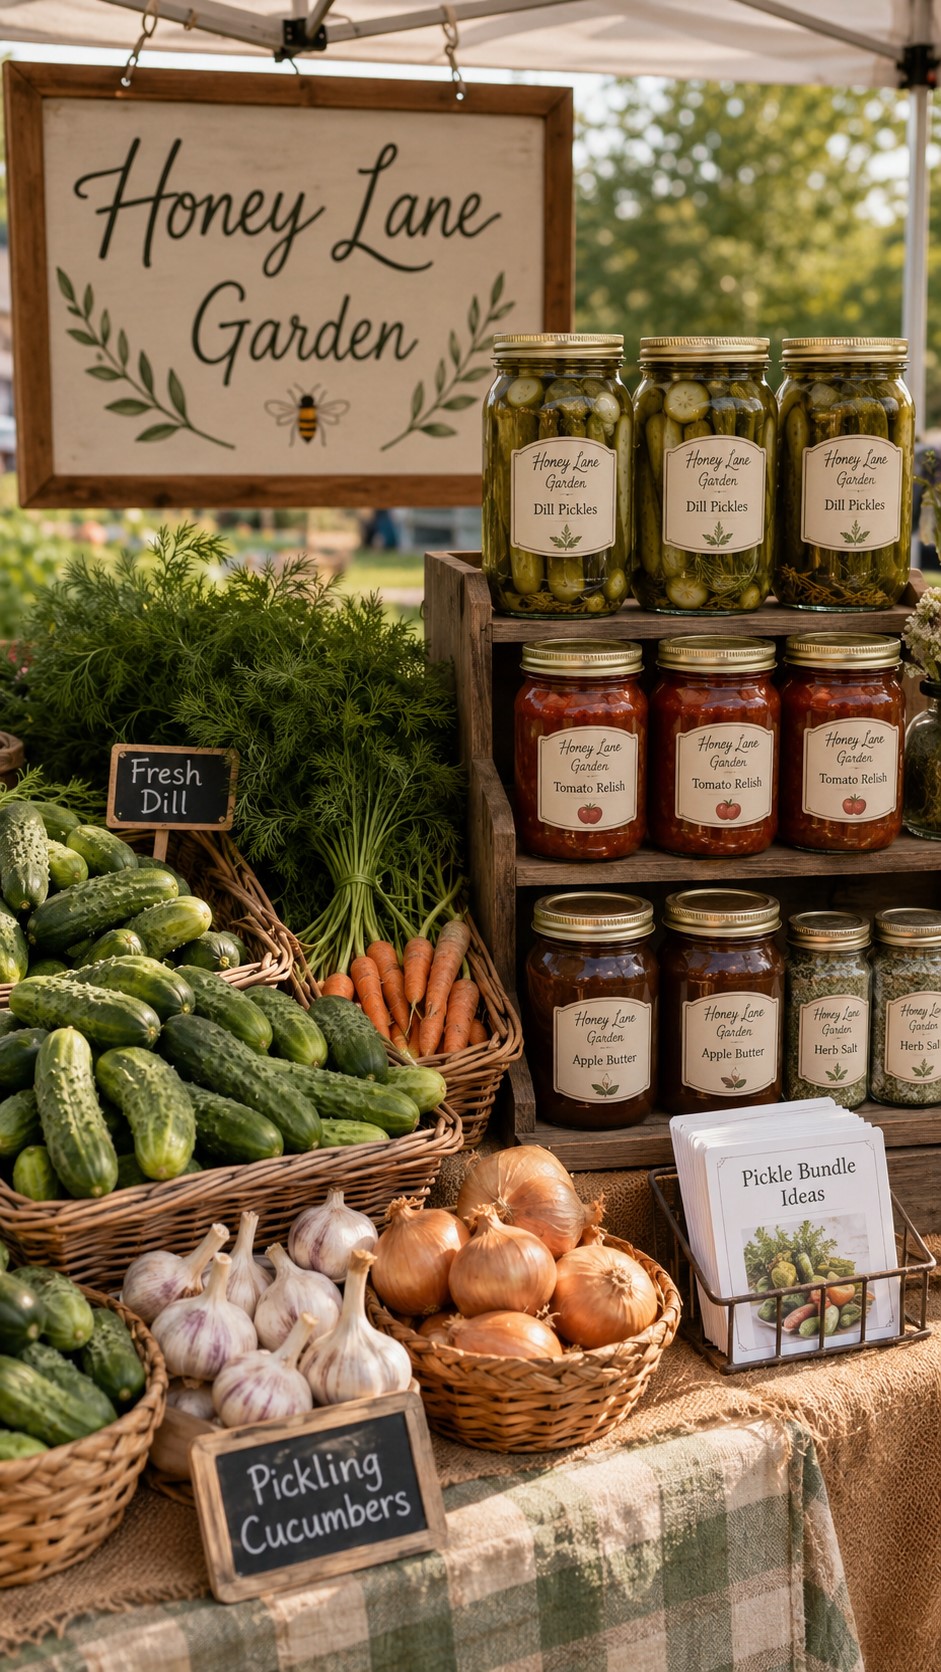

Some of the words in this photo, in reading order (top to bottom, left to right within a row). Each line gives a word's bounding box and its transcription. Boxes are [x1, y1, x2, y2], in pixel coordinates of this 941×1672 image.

[74, 137, 326, 277] Honey
[331, 143, 502, 273] Lane
[191, 280, 419, 386] Garden
[532, 451, 571, 474] Honey
[573, 450, 600, 473] Lane
[686, 450, 723, 472] Honey
[725, 449, 751, 471] Lane
[824, 449, 861, 471] Honey
[863, 448, 888, 469] Lane
[545, 473, 587, 491] Garden
[698, 471, 738, 489] Garden
[836, 470, 876, 488] Garden
[533, 502, 554, 516] Dill
[558, 502, 598, 516] Pickles
[686, 500, 707, 513] Dill
[710, 500, 748, 513] Pickles
[824, 499, 845, 511] Dill
[848, 499, 886, 511] Pickles
[559, 738, 595, 759] Honey
[596, 737, 622, 757] Lane
[698, 735, 733, 757] Honey
[735, 733, 760, 753] Lane
[825, 731, 860, 750] Honey
[861, 730, 885, 749] Lane
[570, 758, 610, 773] Garden
[709, 754, 748, 771] Garden
[836, 750, 873, 766] Garden
[131, 757, 202, 786] Fresh
[819, 772, 858, 785] Tomato
[861, 772, 888, 785] Relish
[553, 781, 593, 794] Tomato
[596, 780, 626, 793] Relish
[692, 777, 732, 791] Tomato
[734, 777, 762, 790] Relish
[140, 788, 187, 815] Dill
[574, 1010, 610, 1031] Honey
[611, 1009, 637, 1029] Lane
[704, 1005, 739, 1025] Honey
[740, 1003, 766, 1023] Lane
[813, 1006, 841, 1023] Honey
[586, 1029, 625, 1046] Garden
[716, 1024, 753, 1040] Garden
[821, 1023, 852, 1037] Garden
[701, 1047, 732, 1062] Apple
[735, 1047, 765, 1059] Butter
[814, 1044, 839, 1055] Herb
[841, 1043, 858, 1055] Salt
[900, 1040, 924, 1051] Herb
[572, 1054, 604, 1069] Apple
[606, 1053, 637, 1066] Butter
[741, 1164, 793, 1188] Pickle
[797, 1157, 857, 1181] Bundle
[781, 1187, 825, 1208] Ideas
[246, 1453, 383, 1506] Pickling
[240, 1491, 411, 1555] Cucumbers
